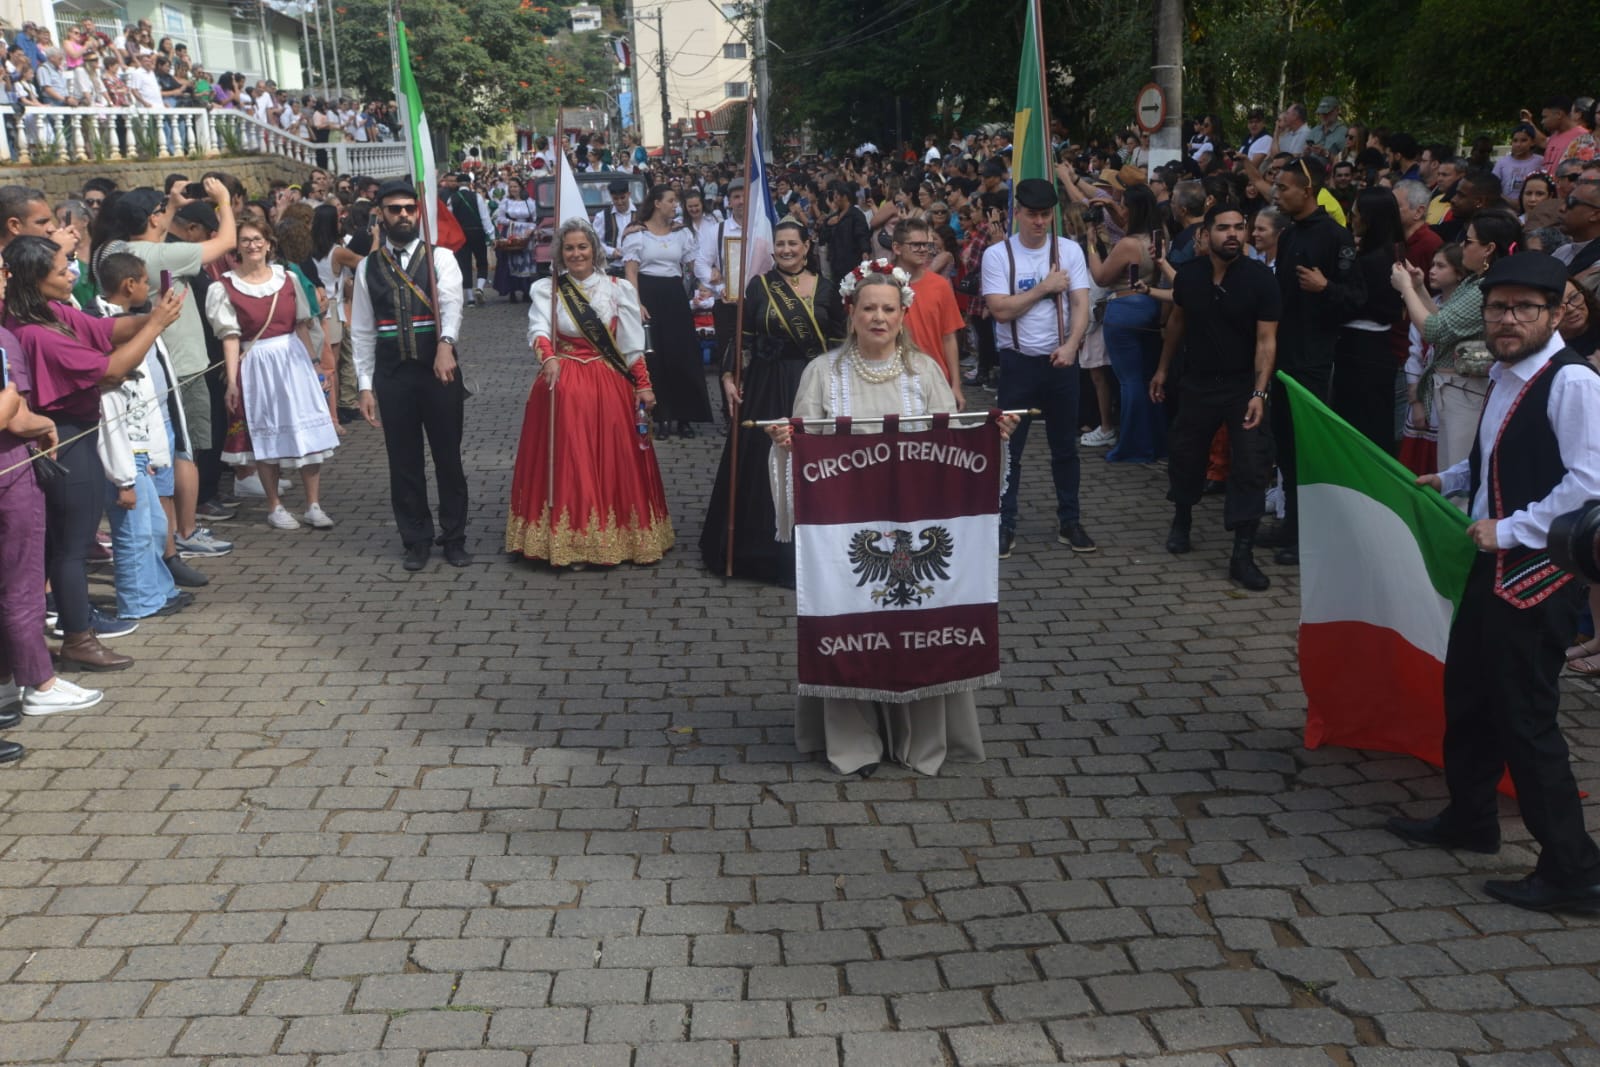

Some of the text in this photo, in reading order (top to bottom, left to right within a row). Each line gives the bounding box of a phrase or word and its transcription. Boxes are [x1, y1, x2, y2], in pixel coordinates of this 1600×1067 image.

[803, 440, 987, 482] CIRCOLO TRENTINO
[817, 626, 986, 656] SANTA TERESA
